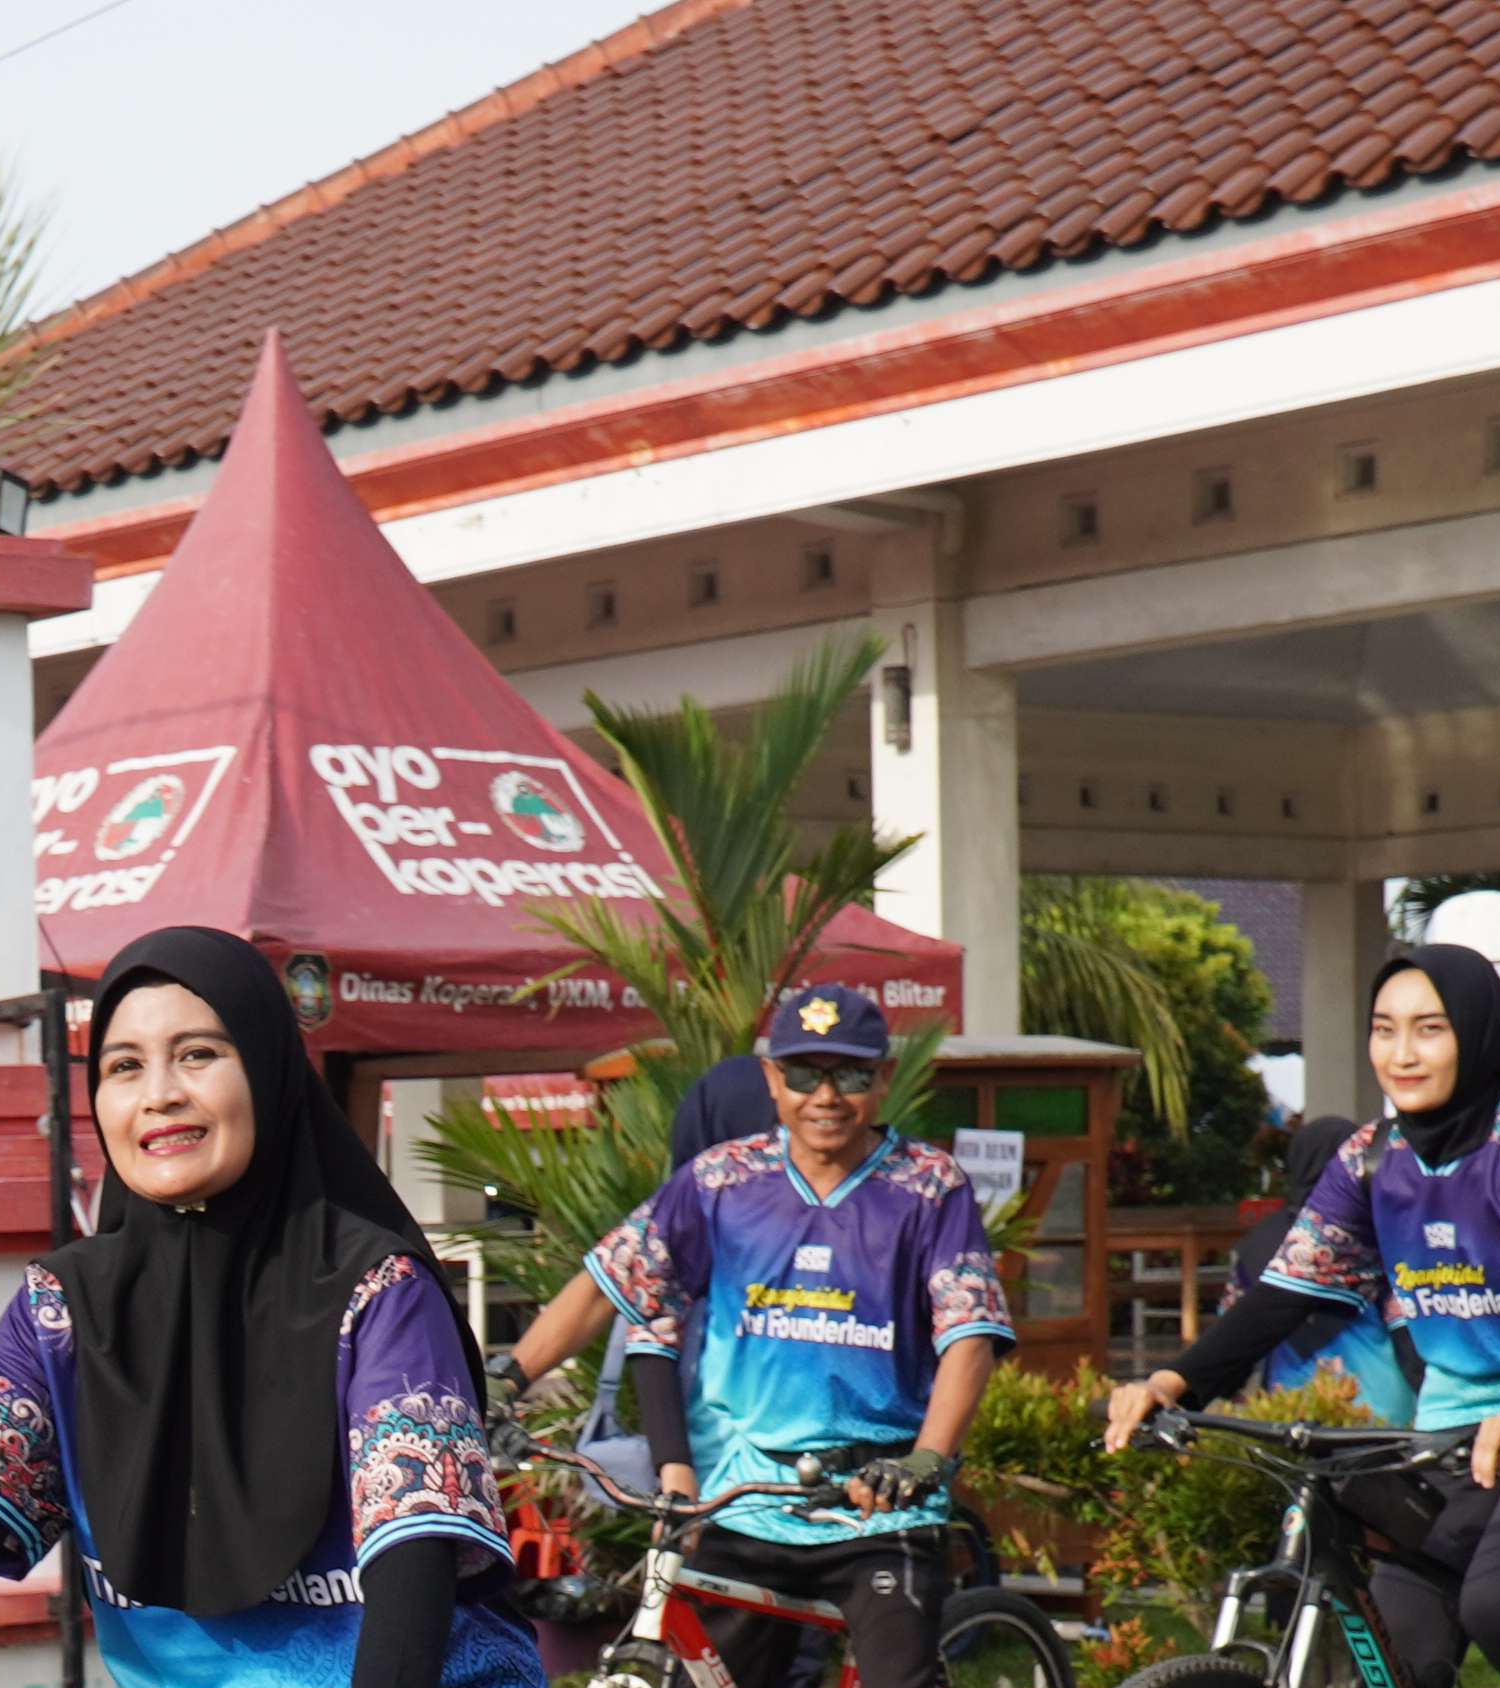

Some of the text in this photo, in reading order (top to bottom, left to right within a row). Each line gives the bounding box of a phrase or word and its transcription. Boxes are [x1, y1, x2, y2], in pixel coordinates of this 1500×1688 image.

[309, 744, 441, 804] ayo
[326, 783, 493, 848] ber-
[365, 841, 666, 907] koperasi
[339, 972, 416, 1003] Dinas
[883, 978, 947, 1008] Blitar
[766, 1307, 895, 1351] Founderland
